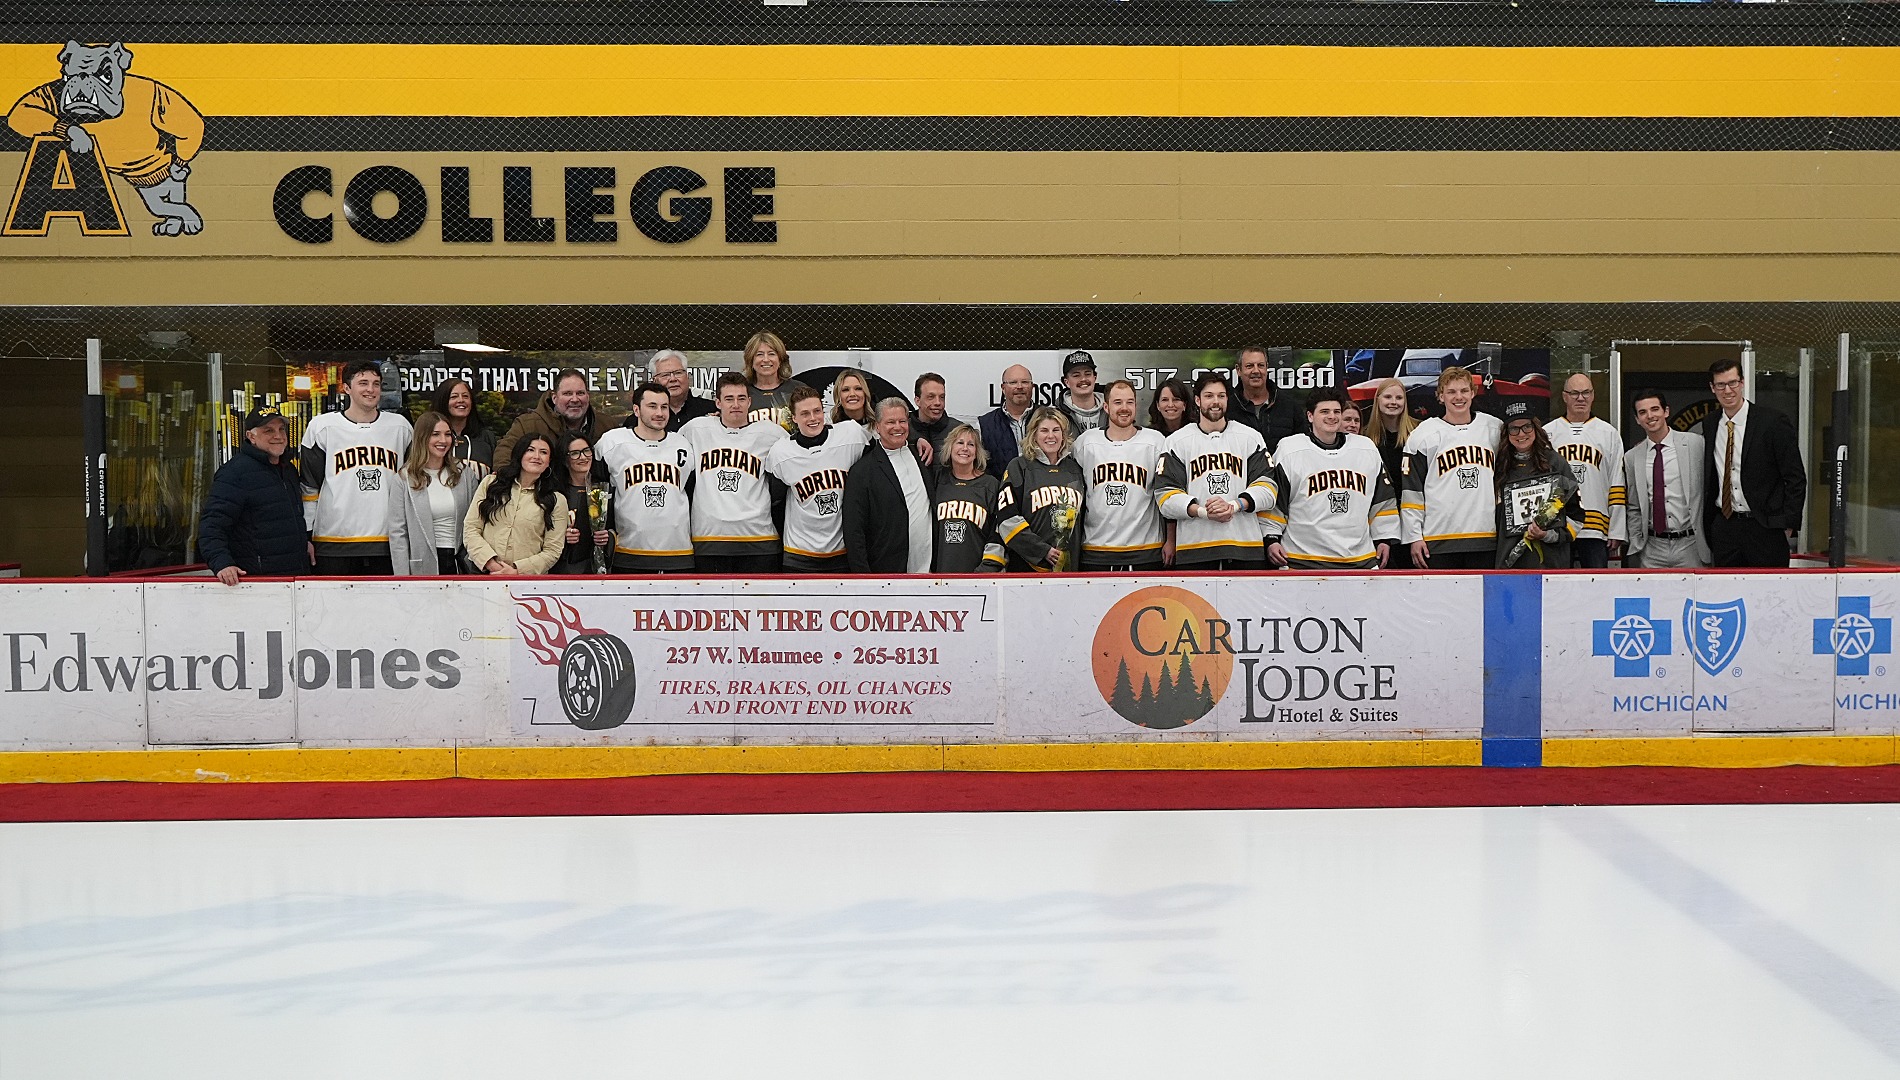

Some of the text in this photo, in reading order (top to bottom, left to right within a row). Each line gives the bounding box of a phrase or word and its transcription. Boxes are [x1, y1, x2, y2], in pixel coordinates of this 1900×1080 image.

[272, 165, 777, 244] COLLEGE
[479, 367, 531, 392] THAT
[537, 367, 600, 392] SCE
[606, 367, 654, 392] EVE
[334, 445, 399, 476] ADRIAN
[676, 448, 688, 468] C
[700, 448, 762, 480] ADRIAN
[1190, 452, 1243, 482] ADRIAN
[1436, 445, 1496, 478] ADRIAN
[1557, 444, 1603, 472] DRIAN
[624, 462, 681, 492] ADRIAN
[1092, 462, 1148, 490] ADRIAN
[1307, 469, 1367, 499] ADRIAN
[998, 486, 1015, 510] 21
[937, 500, 988, 530] DRIAN
[633, 608, 969, 632] HADDEN TIRE COMPANY
[1129, 604, 1368, 657] CARLTON
[667, 646, 940, 665] 237 W. Maumee 265-8131
[659, 679, 952, 698] TIRES, BRAKES, OIL CHANGES
[1239, 657, 1398, 724] LODGE
[1835, 693, 1900, 711] MICHI
[687, 700, 914, 716] AND FRONT END WORK
[1279, 707, 1399, 723] Hotel & Suites
[1613, 694, 1729, 713] MICHIGAN
